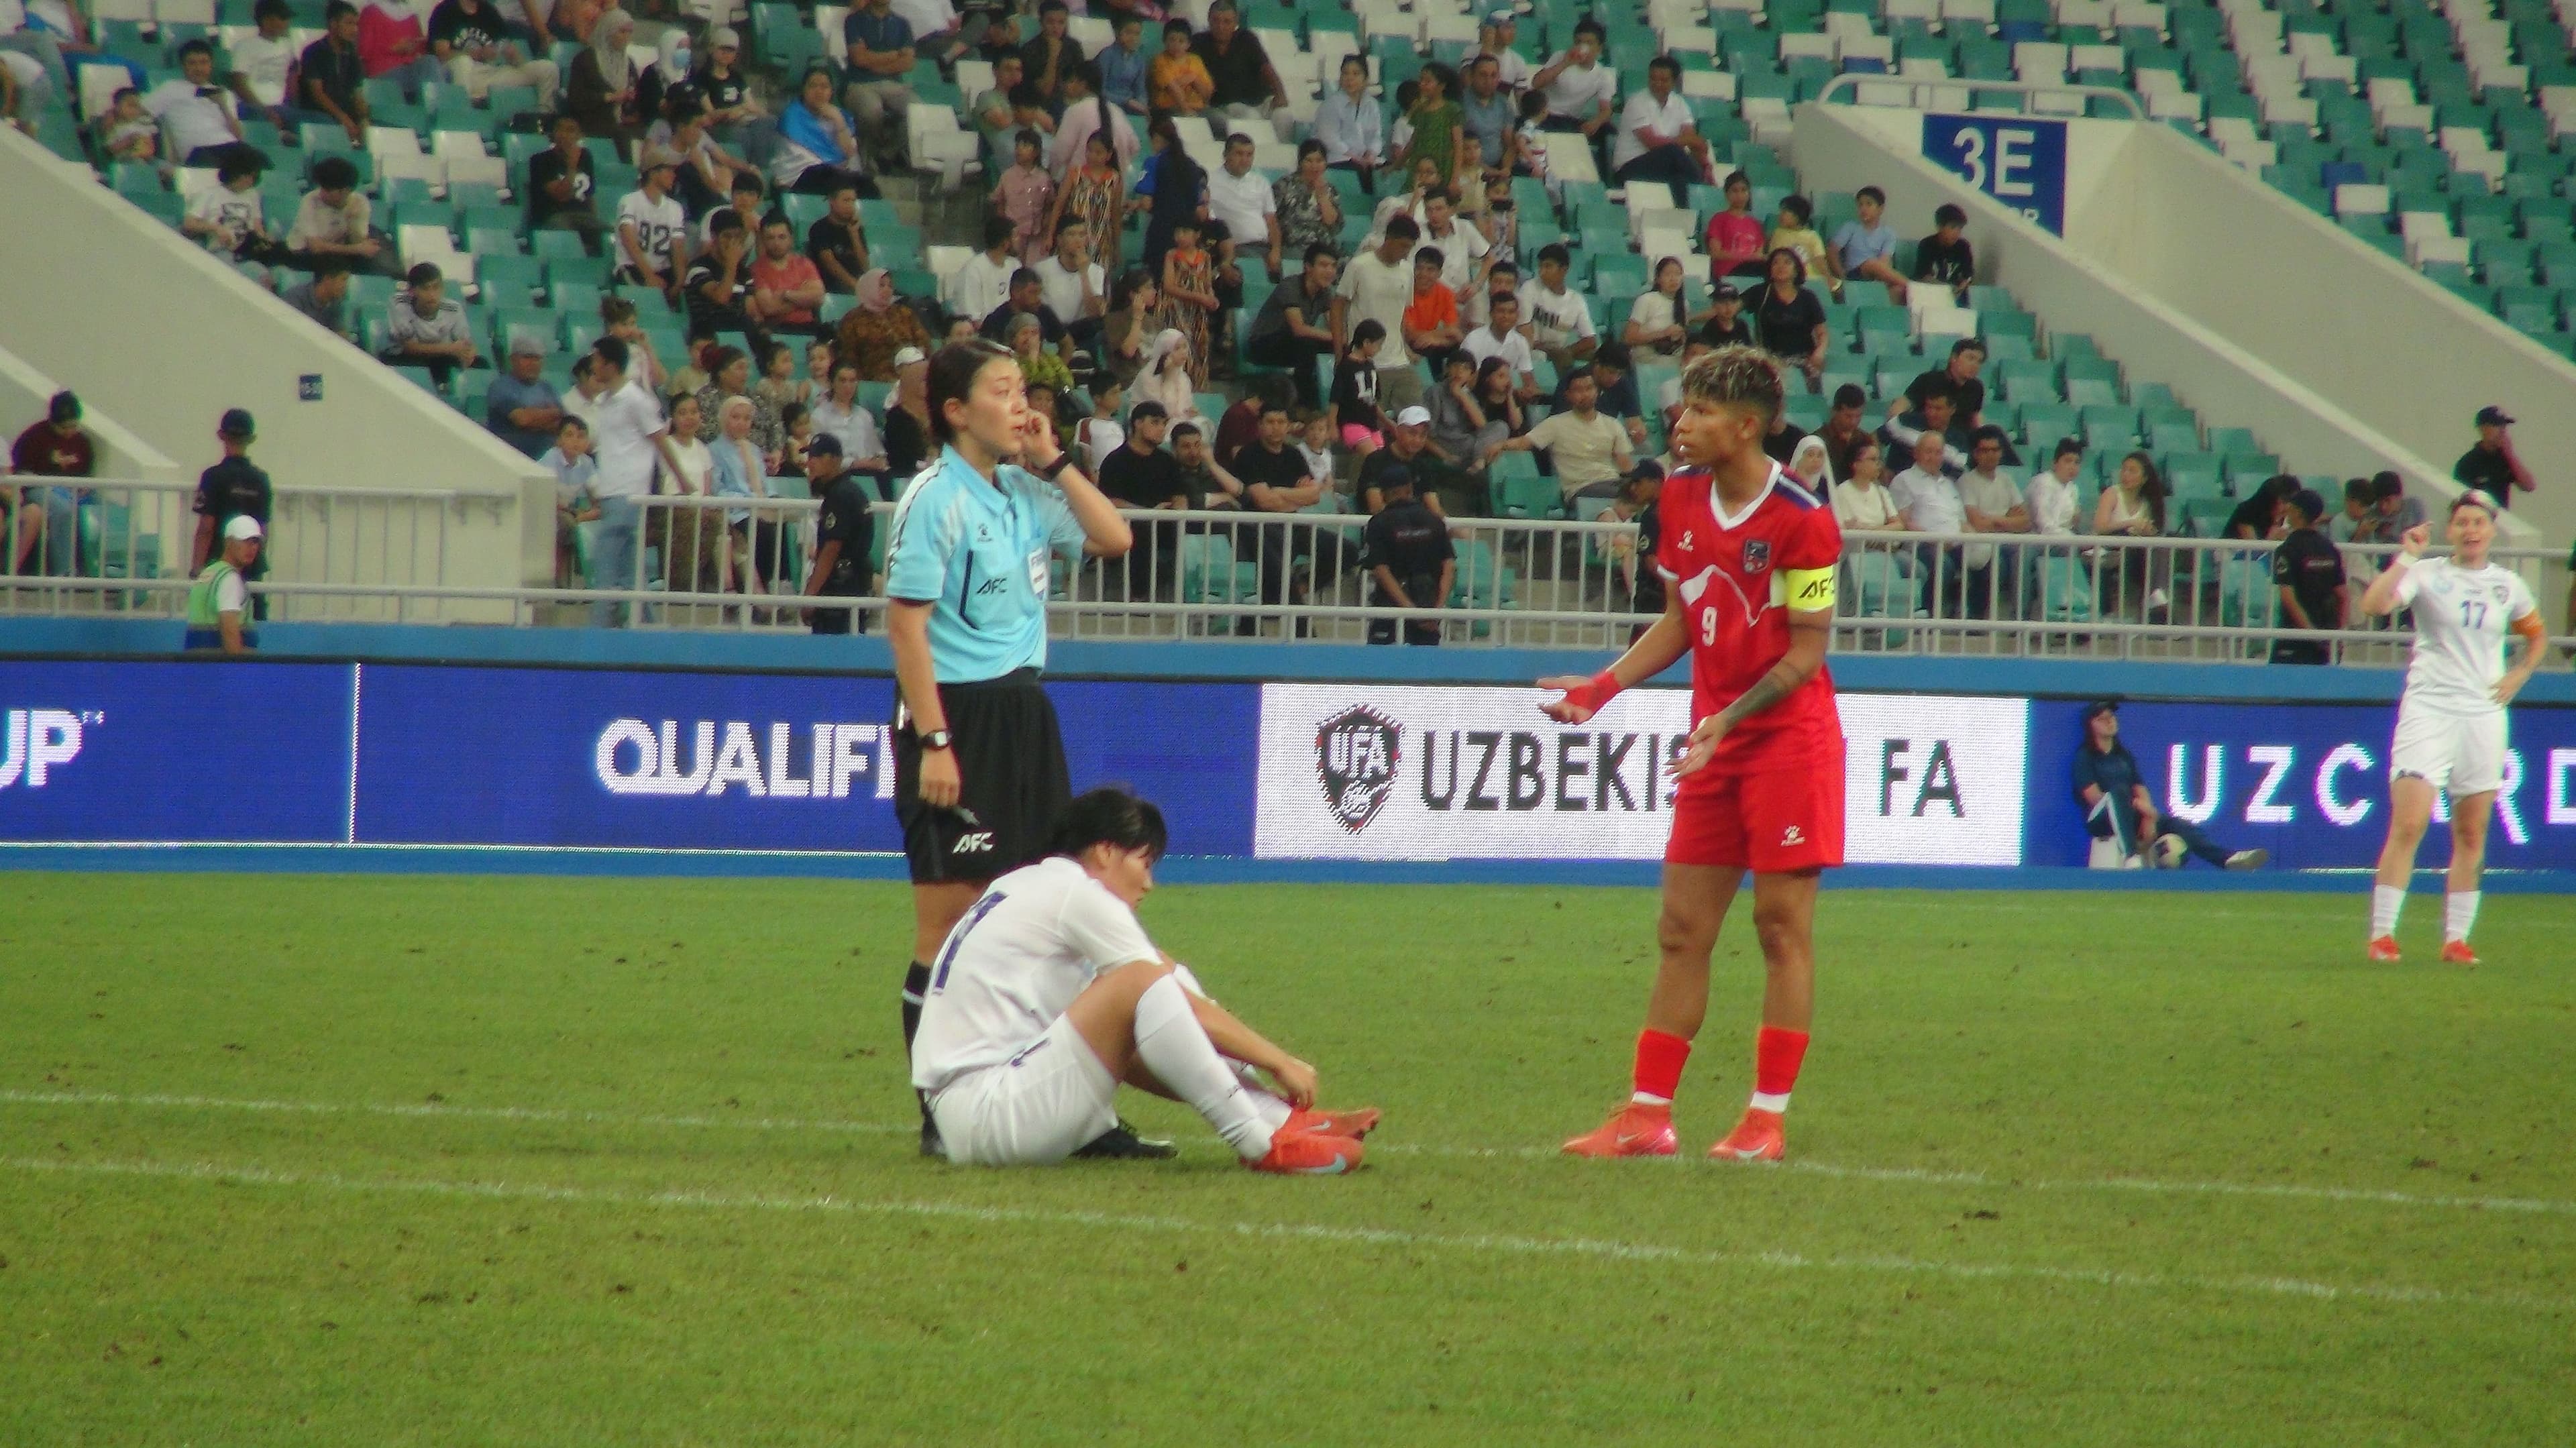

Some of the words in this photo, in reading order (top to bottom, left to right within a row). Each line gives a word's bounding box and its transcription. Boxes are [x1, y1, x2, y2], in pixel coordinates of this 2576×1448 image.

[1953, 127, 2035, 197] 3E
[977, 577, 1008, 595] AFC
[1701, 606, 1718, 647] 9
[2460, 600, 2488, 629] 17
[1328, 725, 1390, 779] UFA
[1878, 739, 1966, 818] FA
[952, 832, 994, 854] AFC
